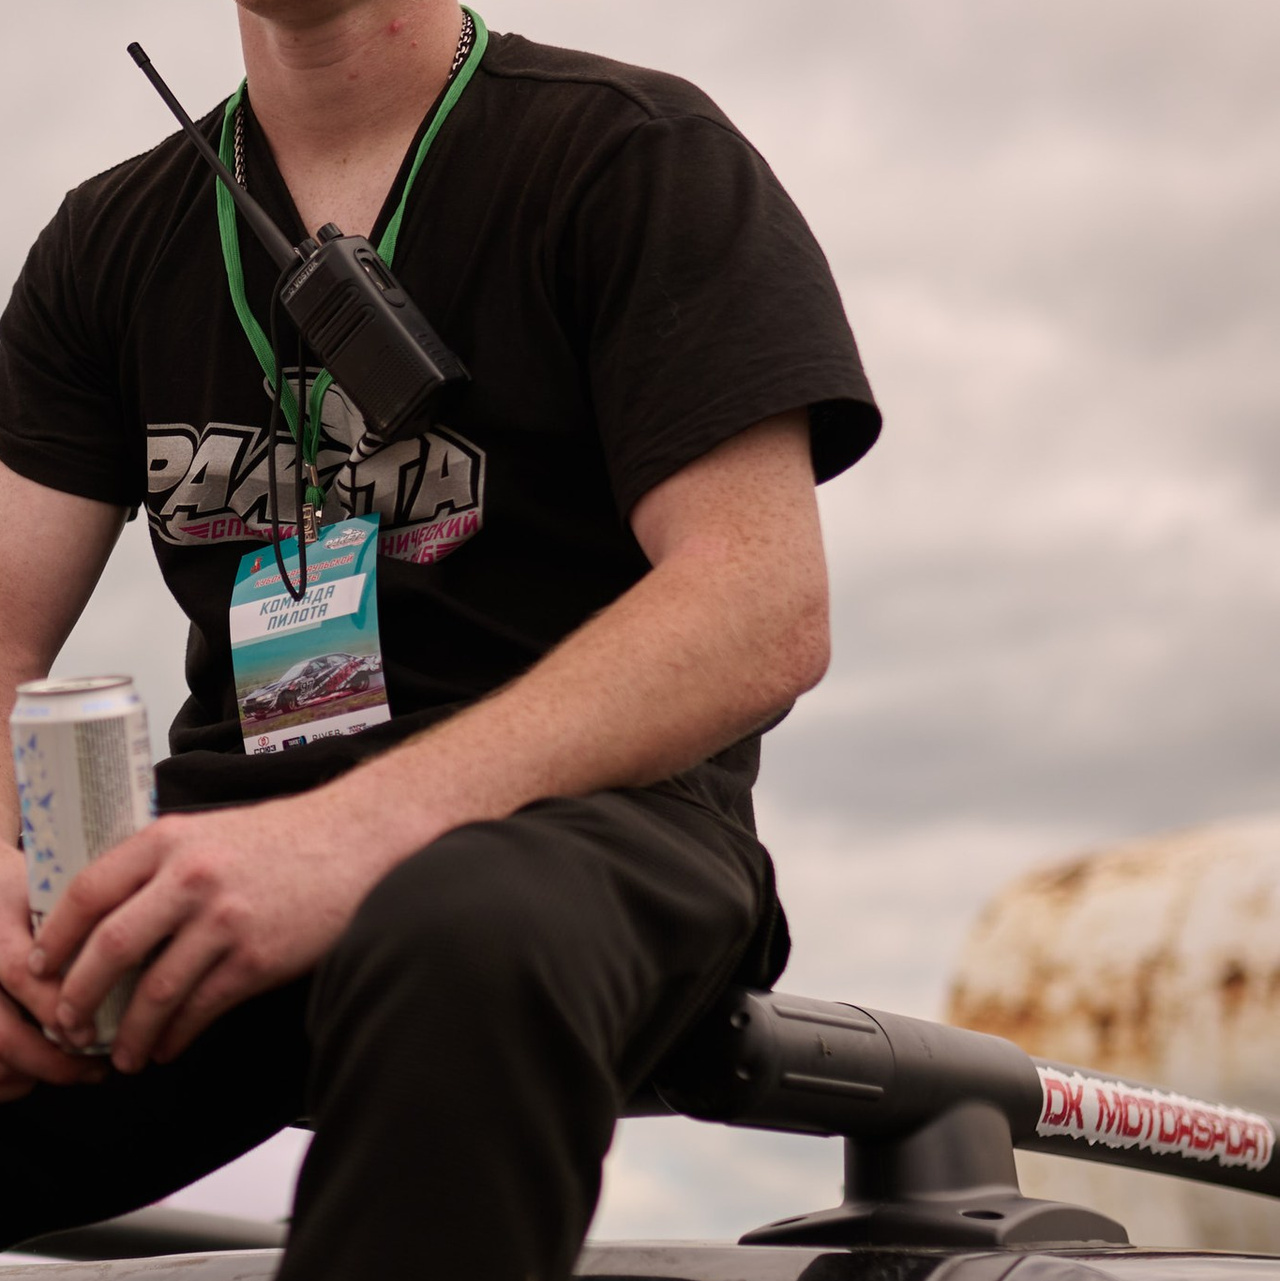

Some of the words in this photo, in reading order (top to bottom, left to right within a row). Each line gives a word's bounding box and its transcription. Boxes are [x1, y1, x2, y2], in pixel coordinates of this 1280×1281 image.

[292, 261, 319, 289] VOSTOK
[267, 603, 328, 631] ПИЛОТА
[1042, 1077, 1084, 1131] DK
